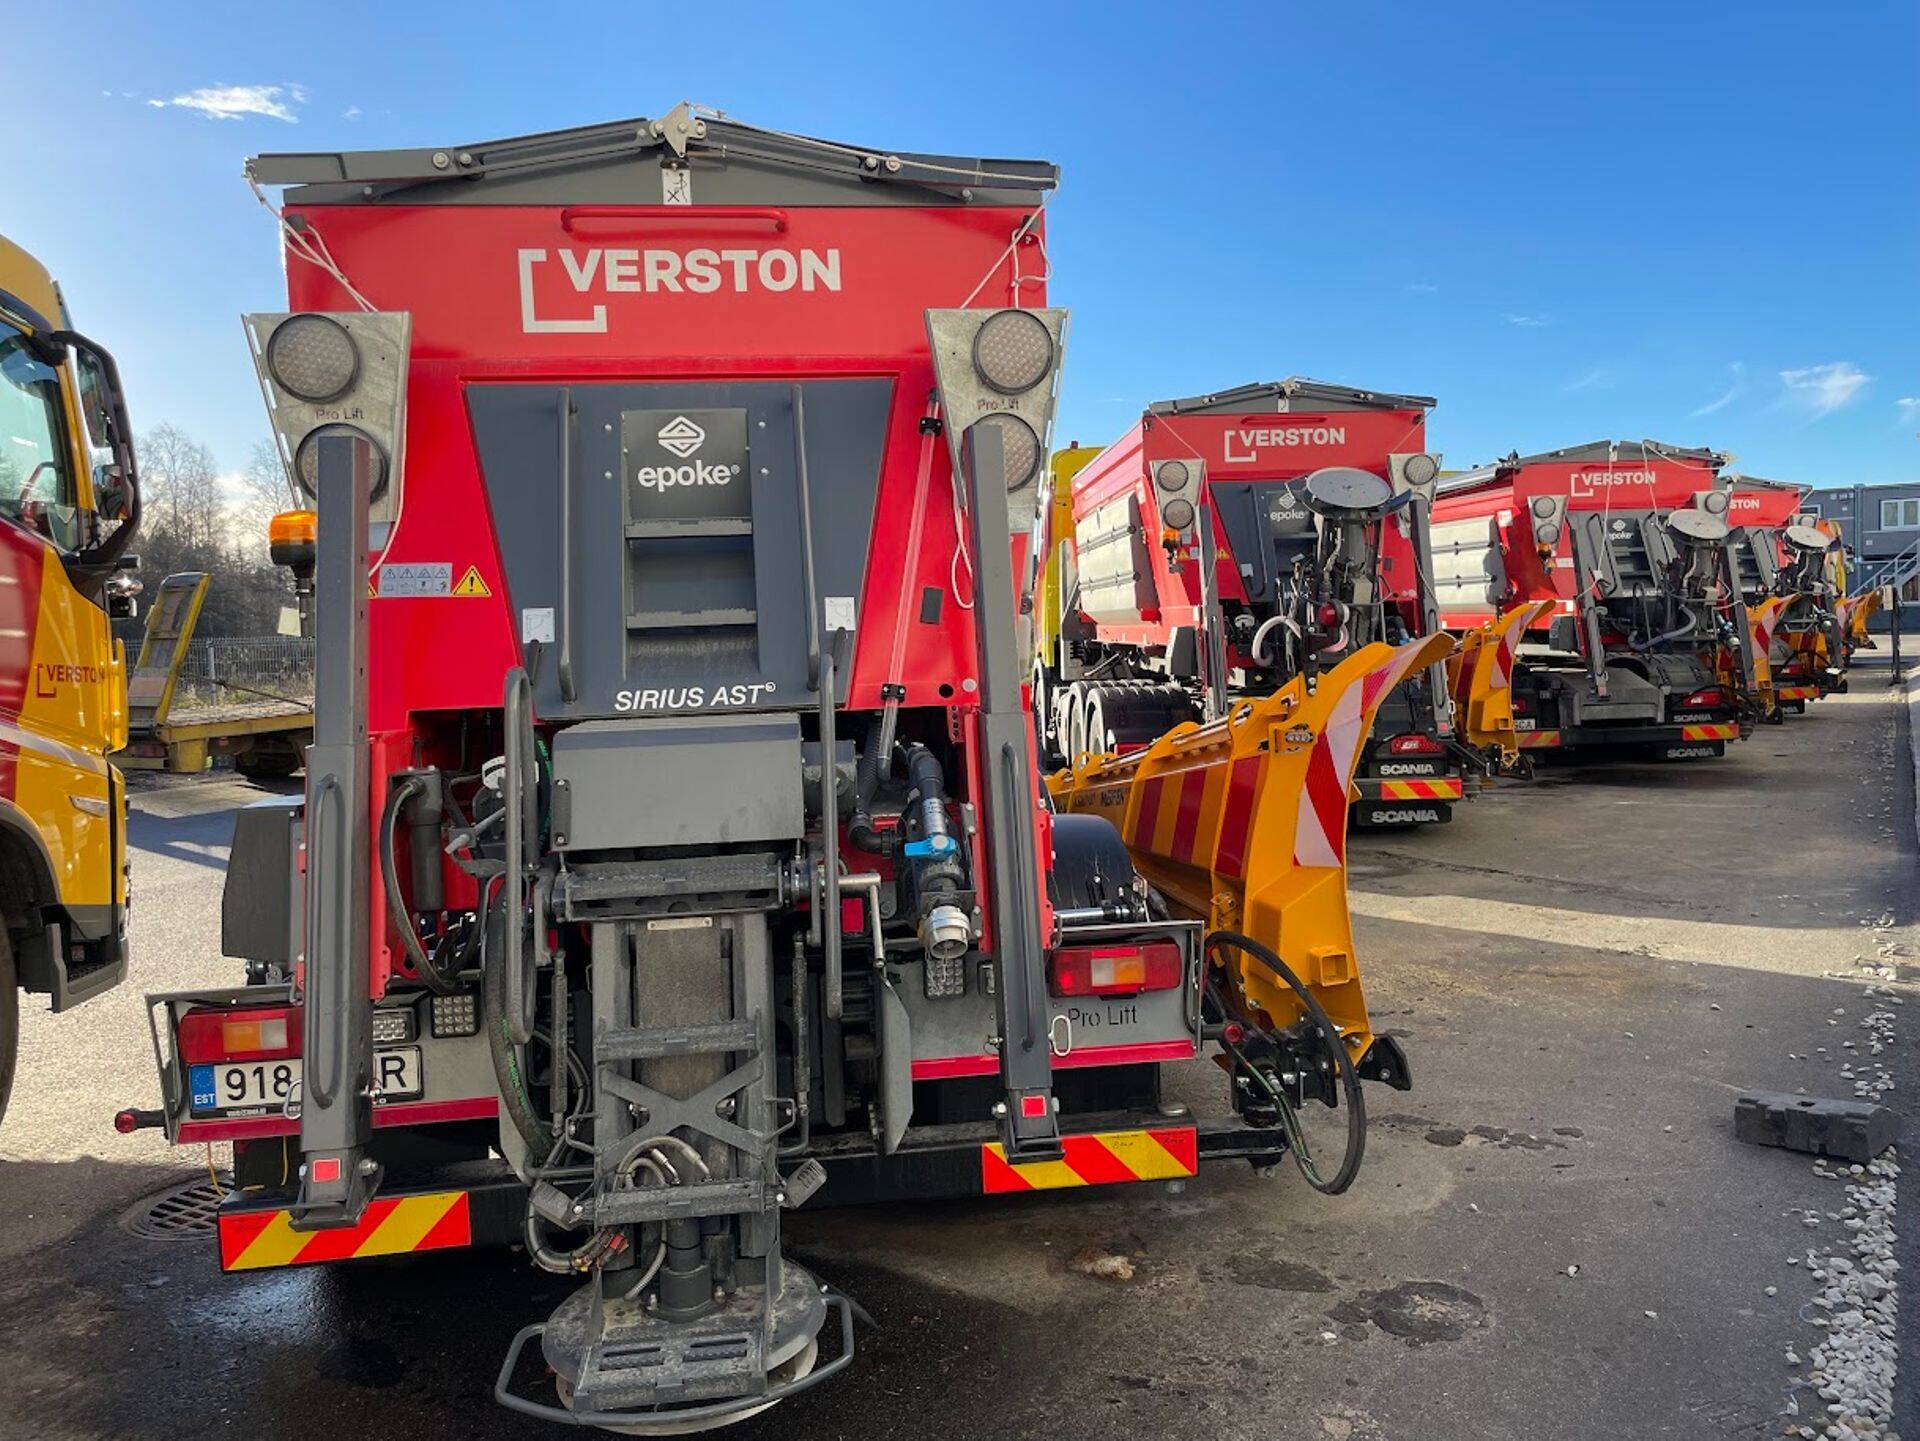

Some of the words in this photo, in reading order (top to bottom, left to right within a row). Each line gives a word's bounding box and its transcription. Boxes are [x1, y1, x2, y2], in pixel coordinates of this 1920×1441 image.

[557, 248, 842, 293] VERSTON
[314, 408, 340, 420] Pro
[343, 407, 365, 420] Lift
[1239, 427, 1346, 447] VERSTON
[1581, 471, 1656, 486] VERSTON
[1729, 498, 1760, 510] STON
[1269, 509, 1305, 521] epoke
[46, 664, 105, 683] VERSTON
[614, 687, 704, 711] SIRIUS
[1673, 713, 1712, 722] SCANIA
[1666, 747, 1715, 759] SCANIA
[1380, 763, 1435, 775] SCANIA
[1371, 809, 1439, 823] SCANIA
[1067, 1007, 1101, 1028] Pro
[1107, 1004, 1138, 1026] Lift
[224, 1063, 293, 1101] 918
[194, 1091, 216, 1105] EST
